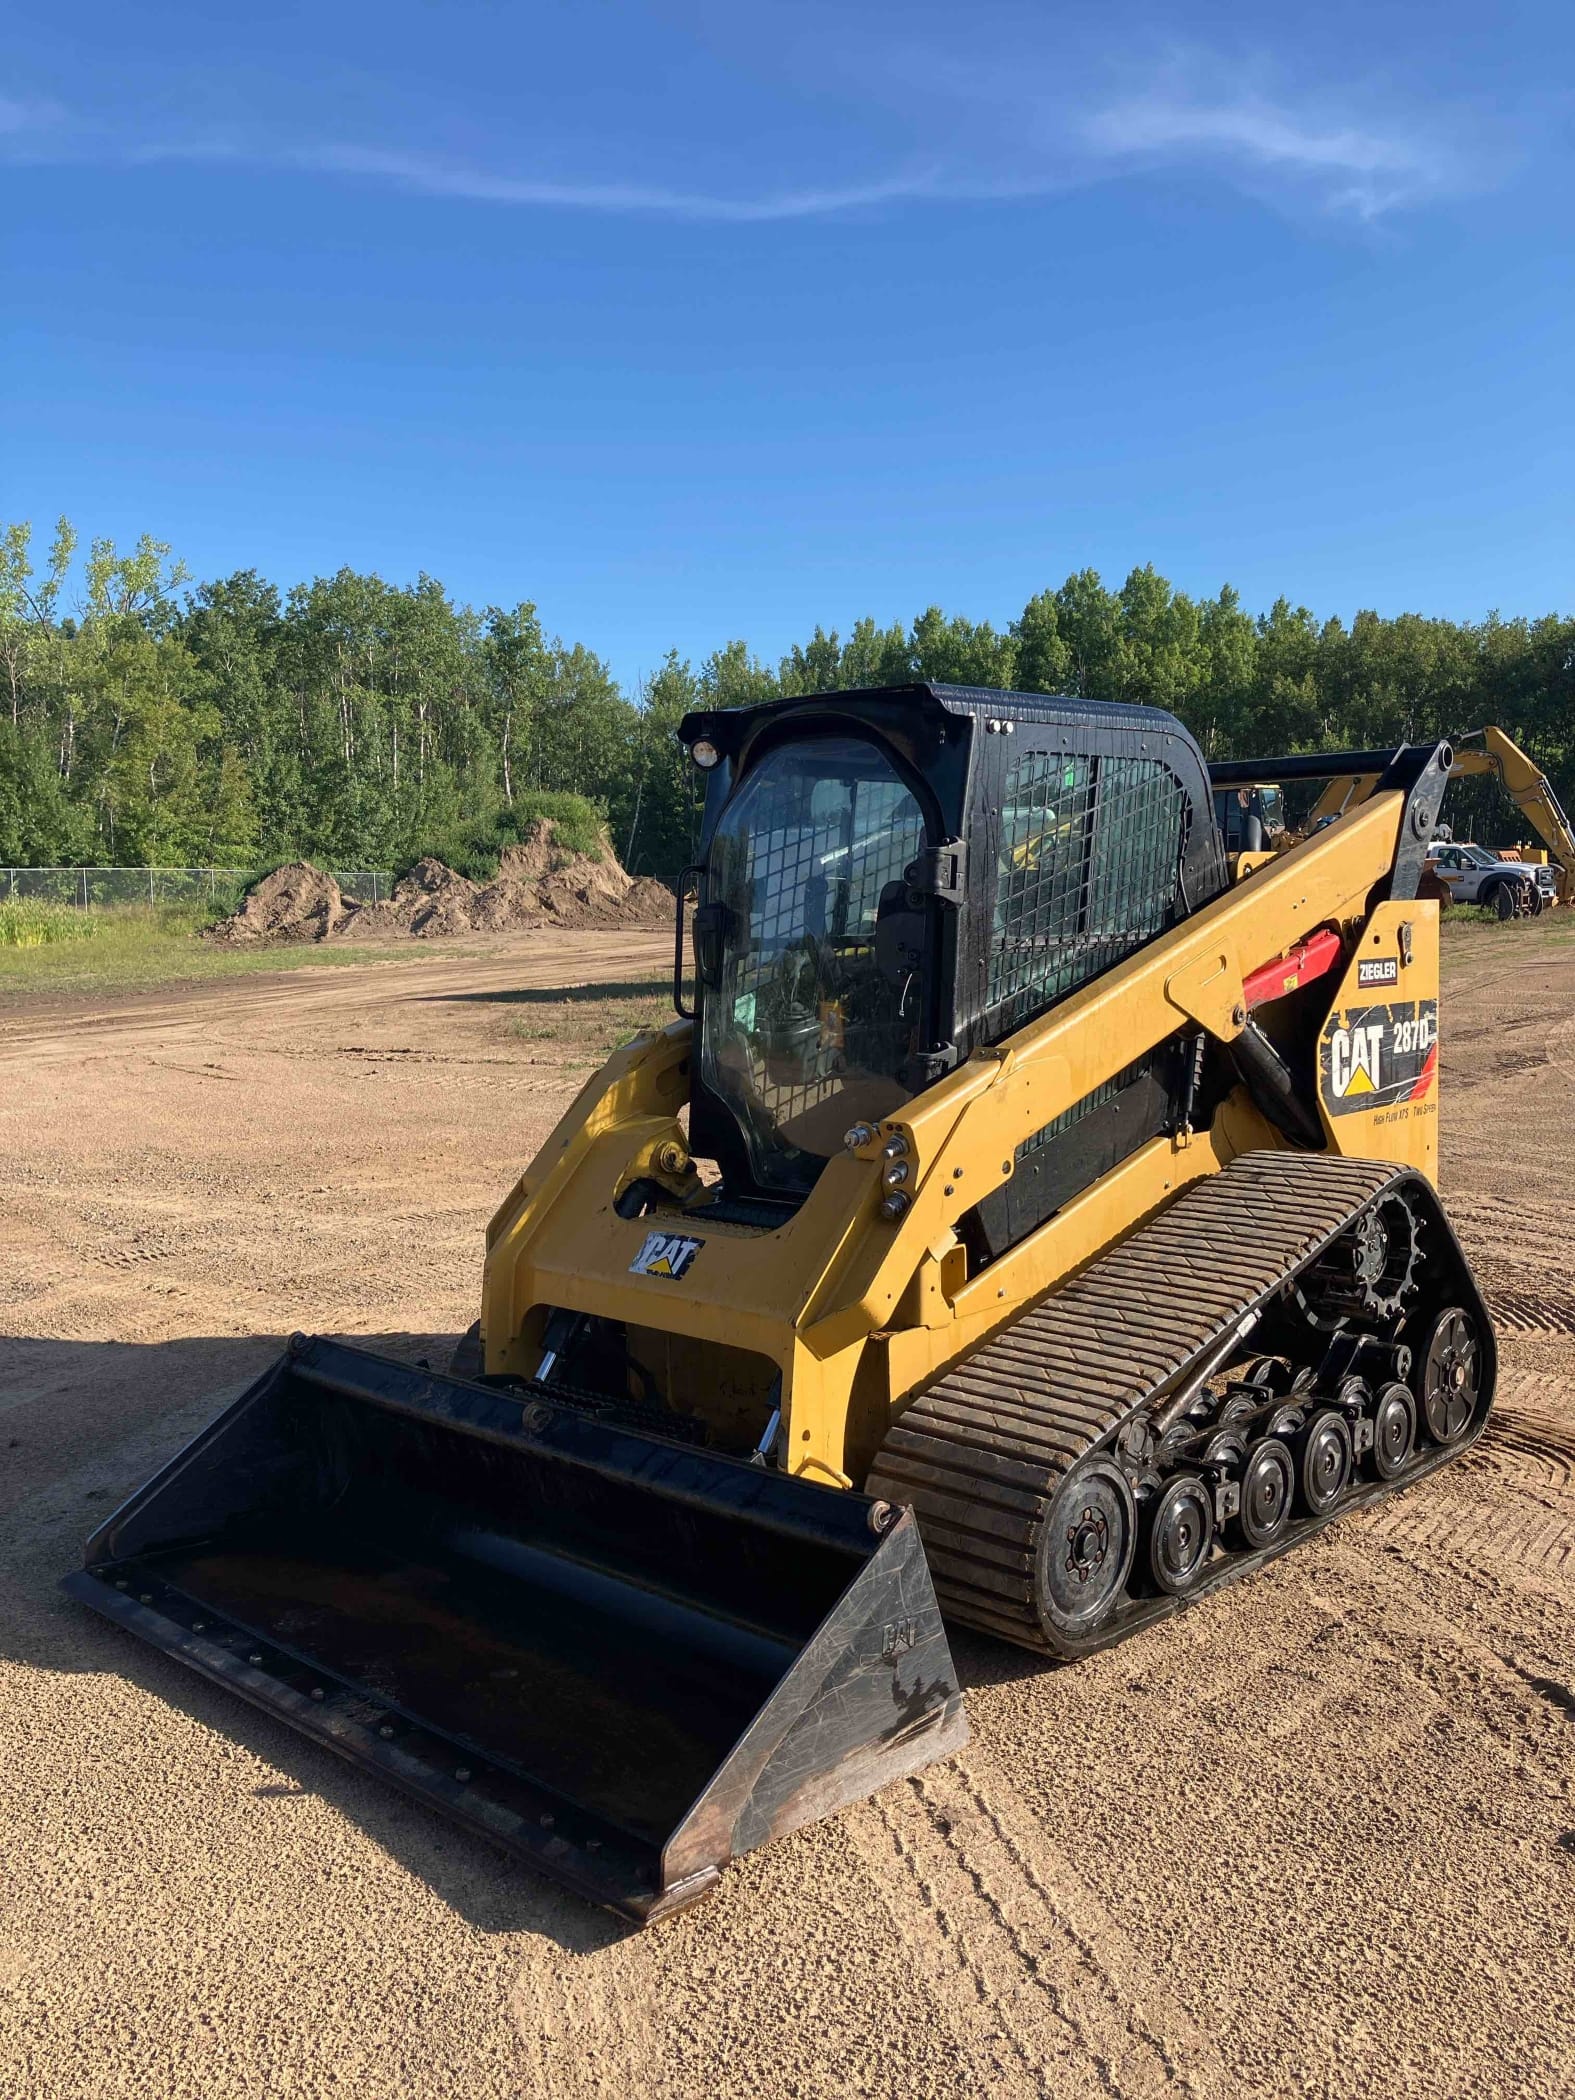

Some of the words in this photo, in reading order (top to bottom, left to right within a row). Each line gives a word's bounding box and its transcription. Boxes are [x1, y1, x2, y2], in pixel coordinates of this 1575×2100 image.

[1360, 961, 1396, 981] ZIEGLER
[1332, 1025, 1384, 1097] CAT
[1394, 1019, 1428, 1054] 287D
[638, 1236, 700, 1275] CAT
